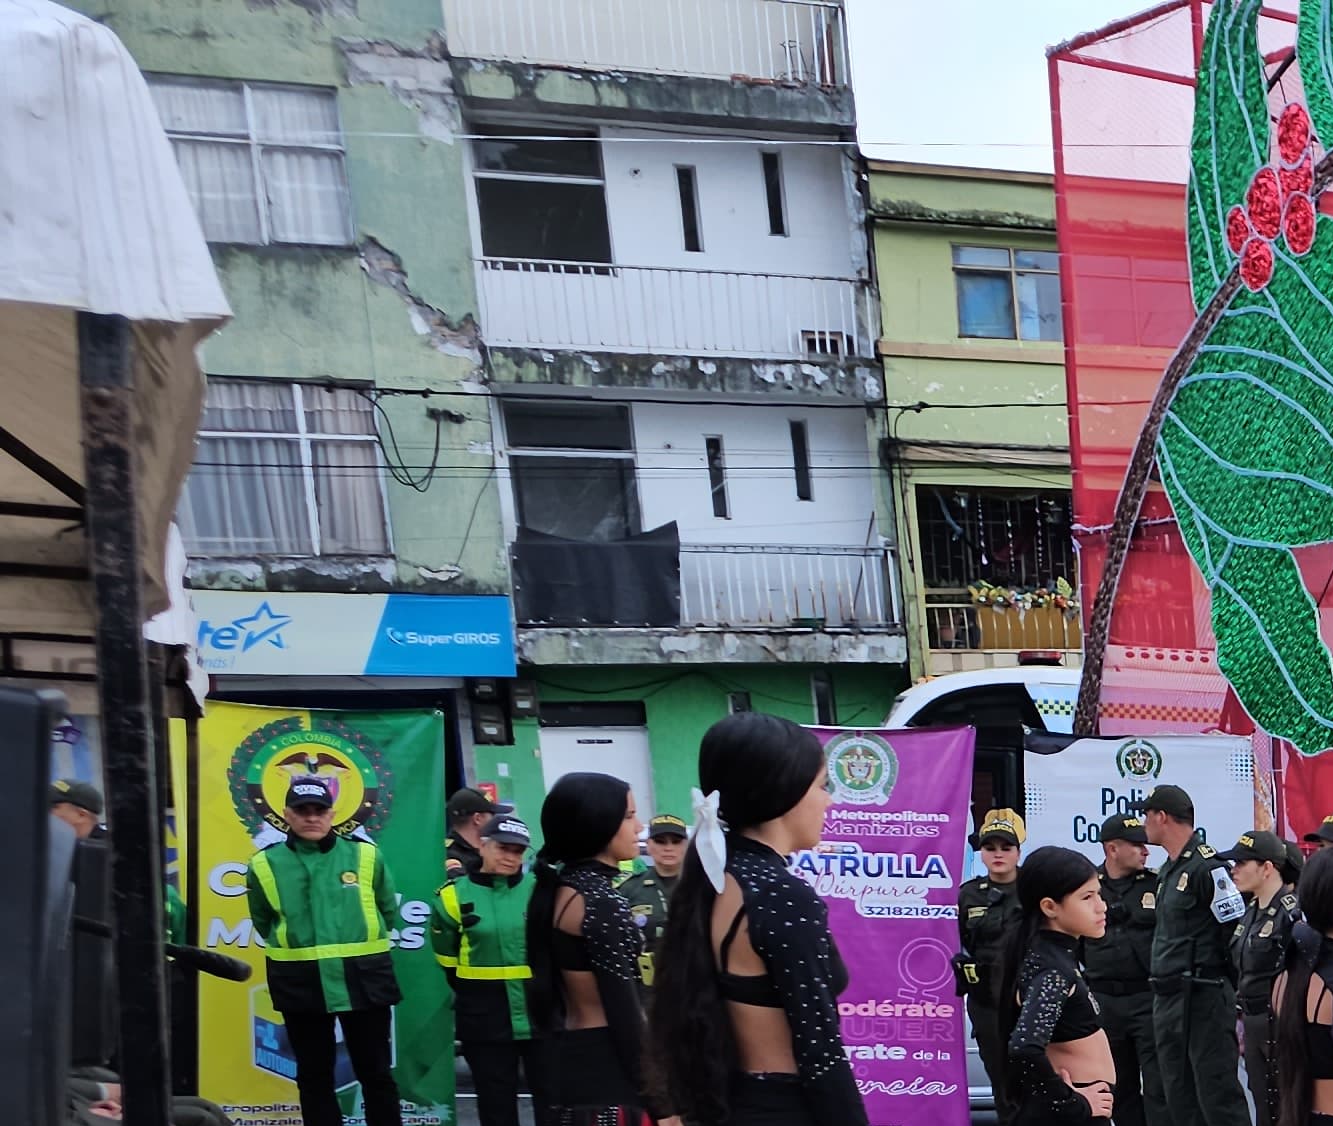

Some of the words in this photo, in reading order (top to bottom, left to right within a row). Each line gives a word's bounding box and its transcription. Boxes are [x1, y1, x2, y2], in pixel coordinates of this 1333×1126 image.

[280, 732, 343, 750] COLOMBIA
[264, 813, 290, 833] POLI
[831, 809, 950, 823] Metropolitana
[821, 820, 940, 837] Manizales
[790, 853, 947, 879] ATRULLA
[838, 999, 955, 1018] odérate
[843, 1017, 955, 1041] UJER
[912, 1049, 934, 1061] de
[937, 1049, 951, 1060] la
[222, 1103, 301, 1115] tropolita
